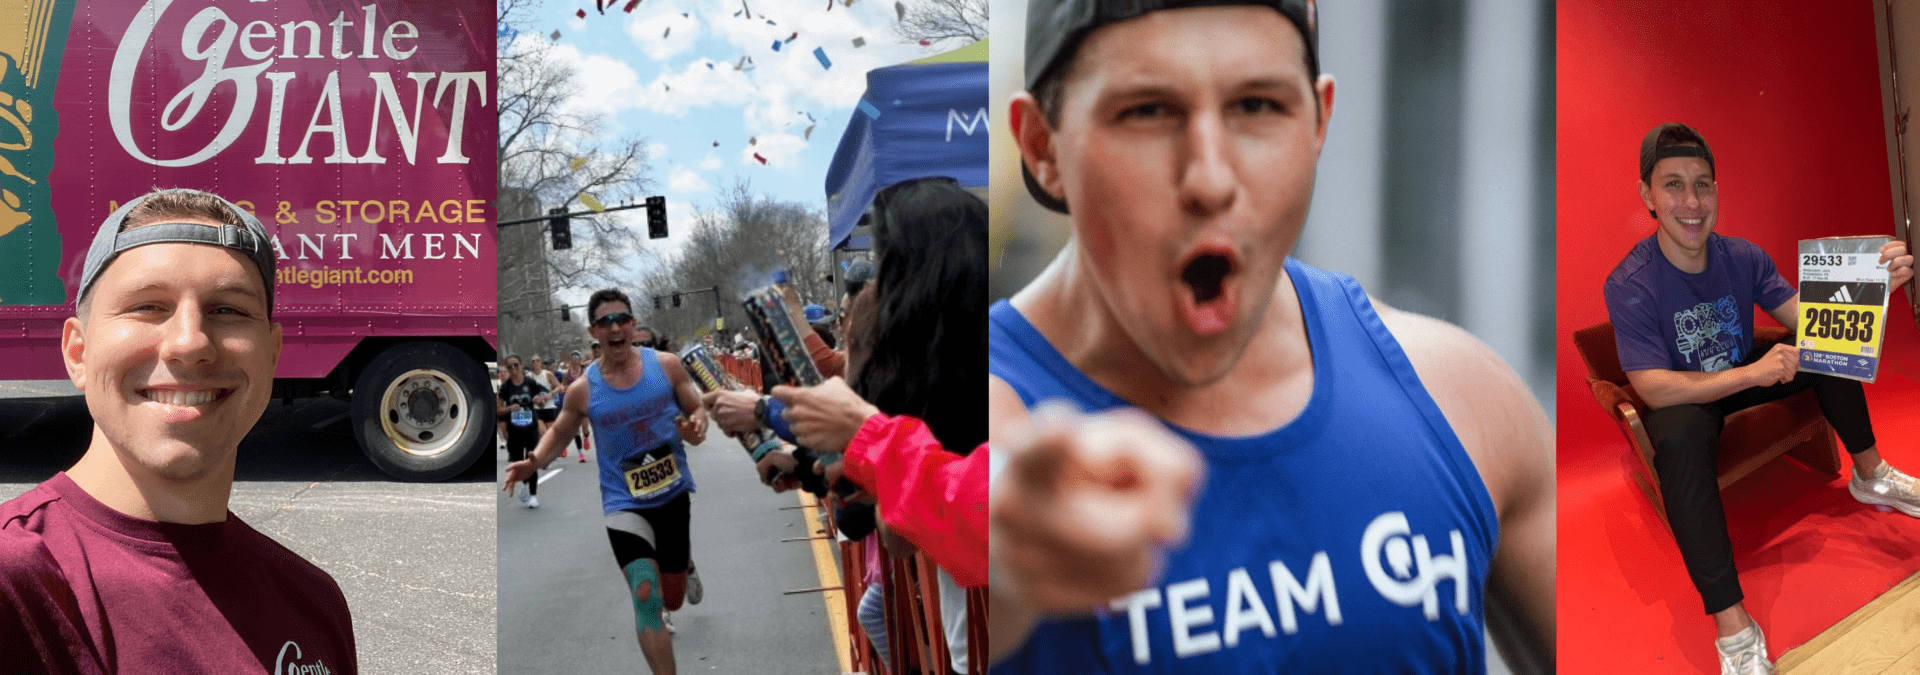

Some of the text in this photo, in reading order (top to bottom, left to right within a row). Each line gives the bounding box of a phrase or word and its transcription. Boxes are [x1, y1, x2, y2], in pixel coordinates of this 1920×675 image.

[276, 201, 297, 224] &
[315, 200, 486, 224] STORAGE
[270, 233, 481, 260] ANT MEN
[1803, 255, 1842, 265] 29533
[275, 265, 414, 289] ntlegiant.com
[1805, 308, 1874, 342] 29533
[1813, 358, 1848, 366] MARATHON
[631, 459, 674, 489] 29533
[1110, 550, 1344, 665] TEAM
